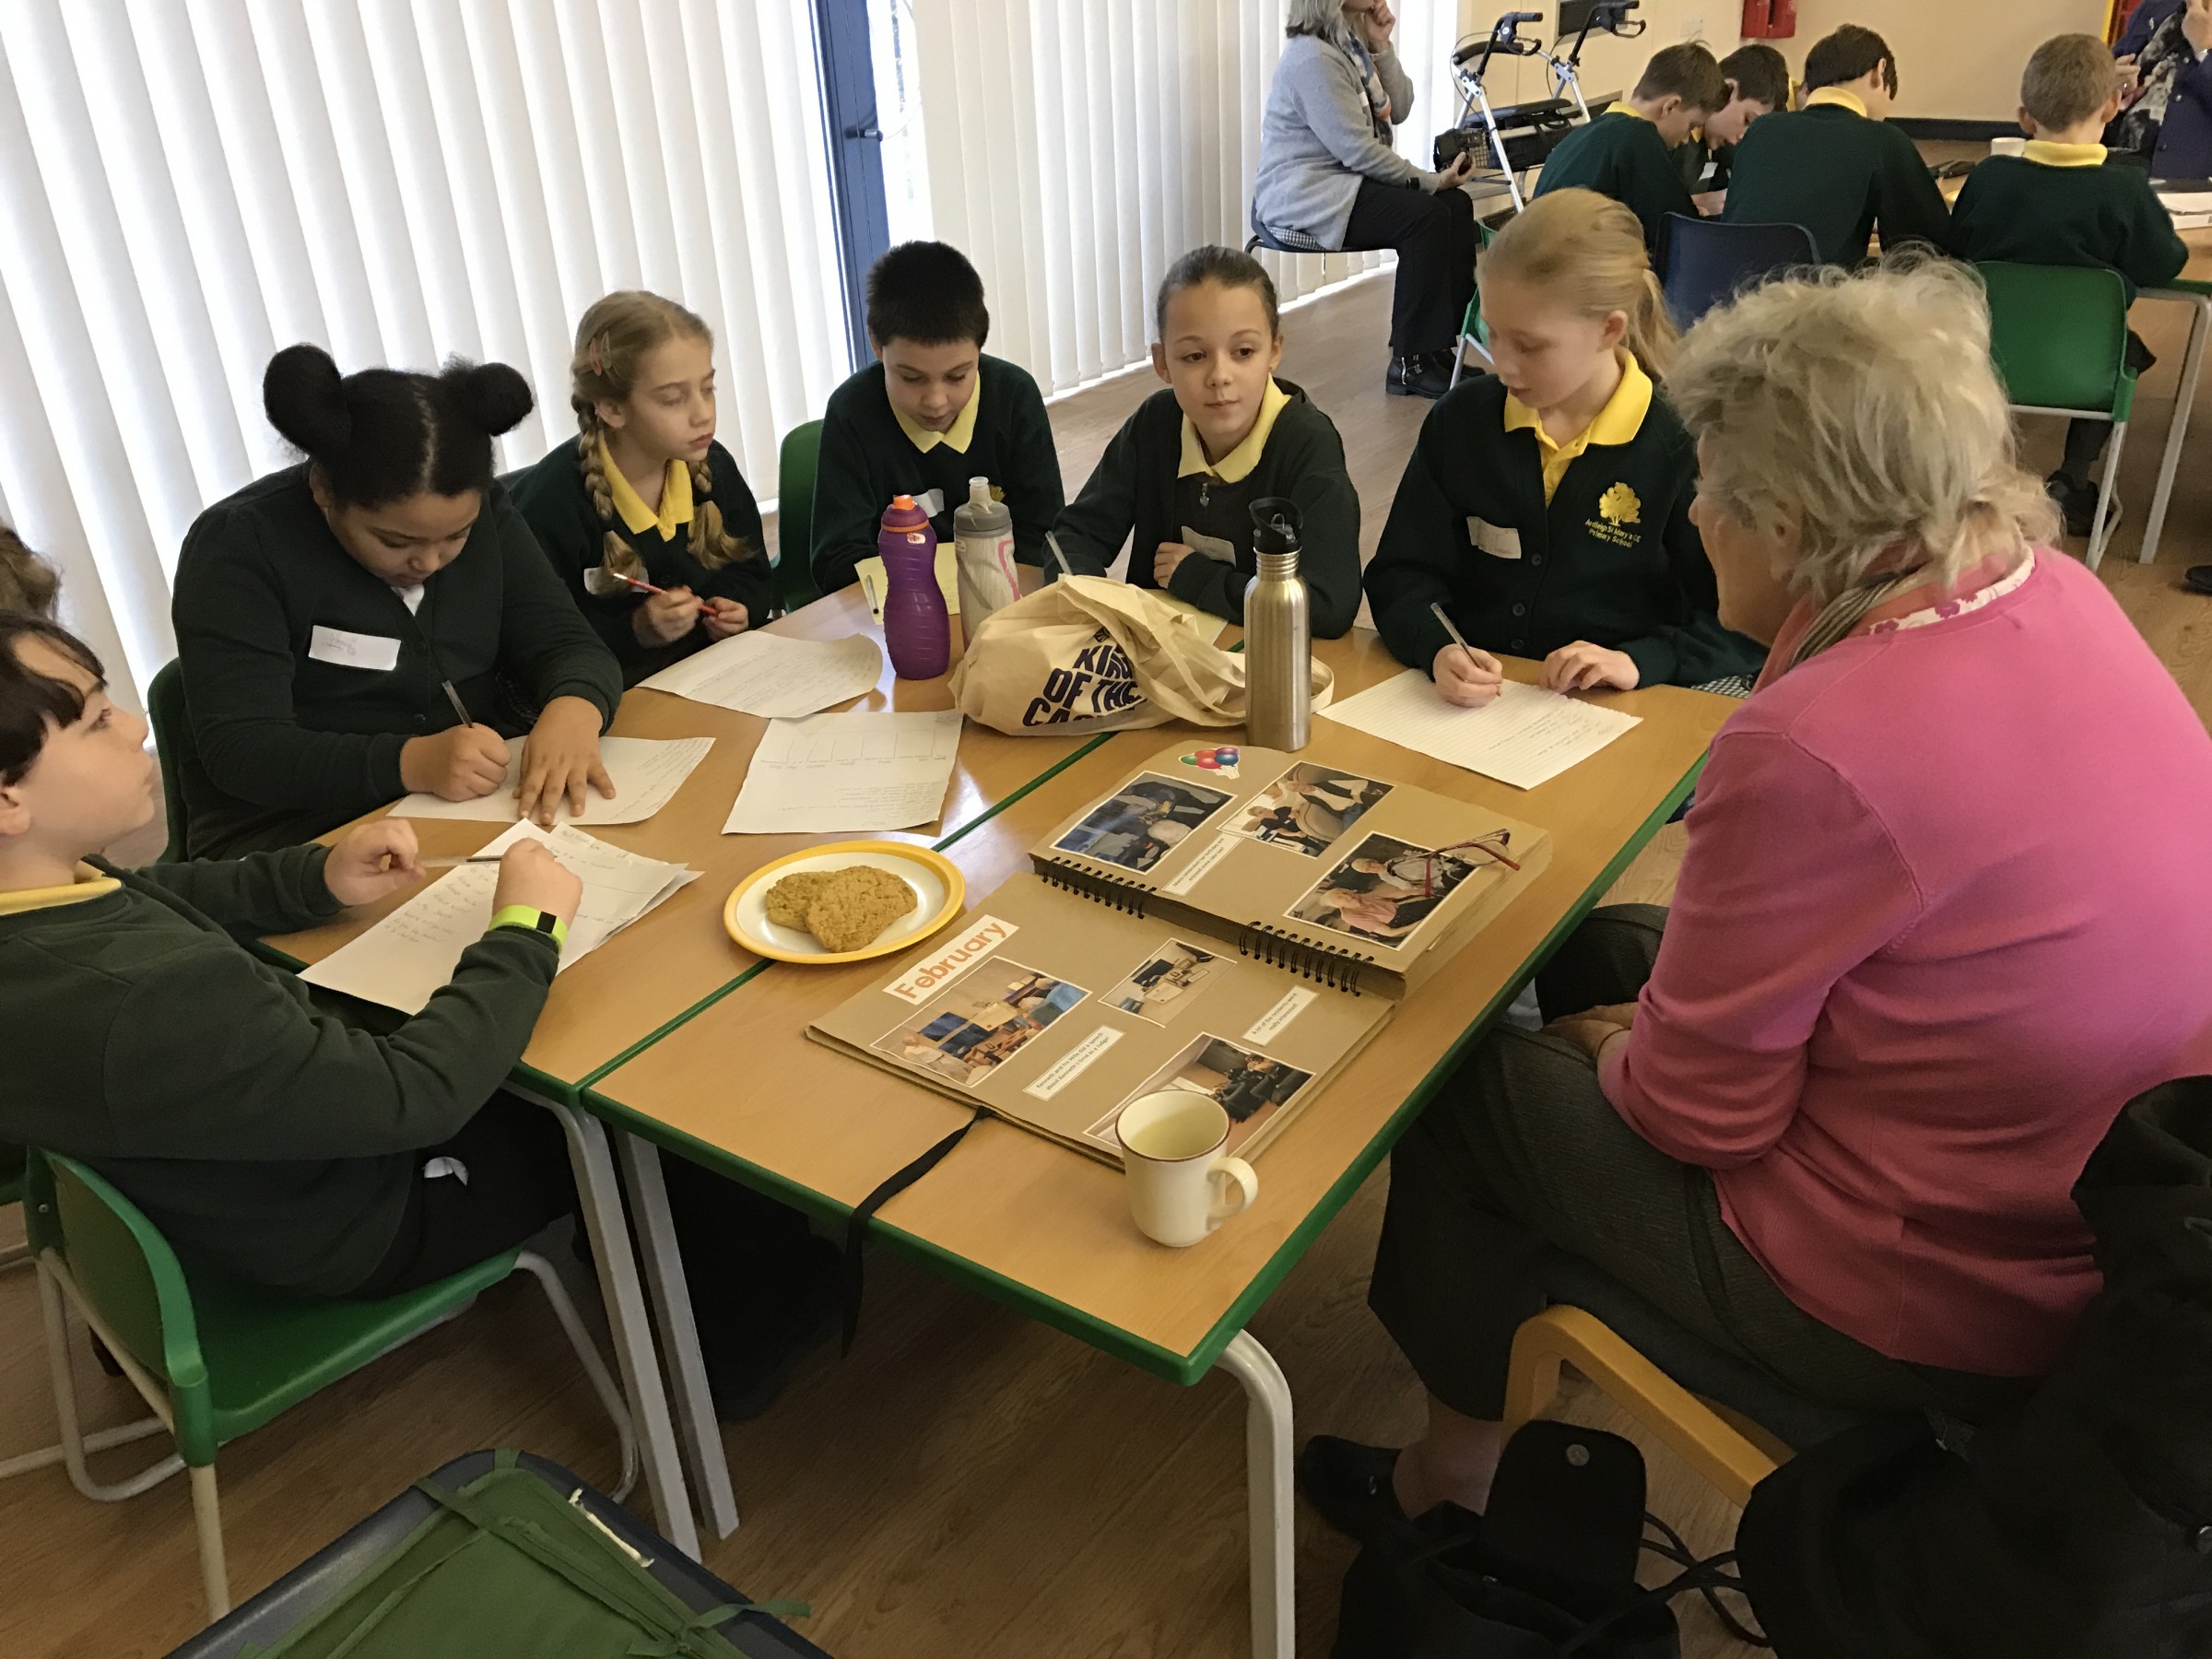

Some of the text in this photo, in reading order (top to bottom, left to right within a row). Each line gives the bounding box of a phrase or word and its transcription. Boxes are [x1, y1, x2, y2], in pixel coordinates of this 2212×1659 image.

[1612, 535, 1633, 548] School
[1043, 667, 1142, 713] OF THE
[893, 922, 1007, 1000] February
